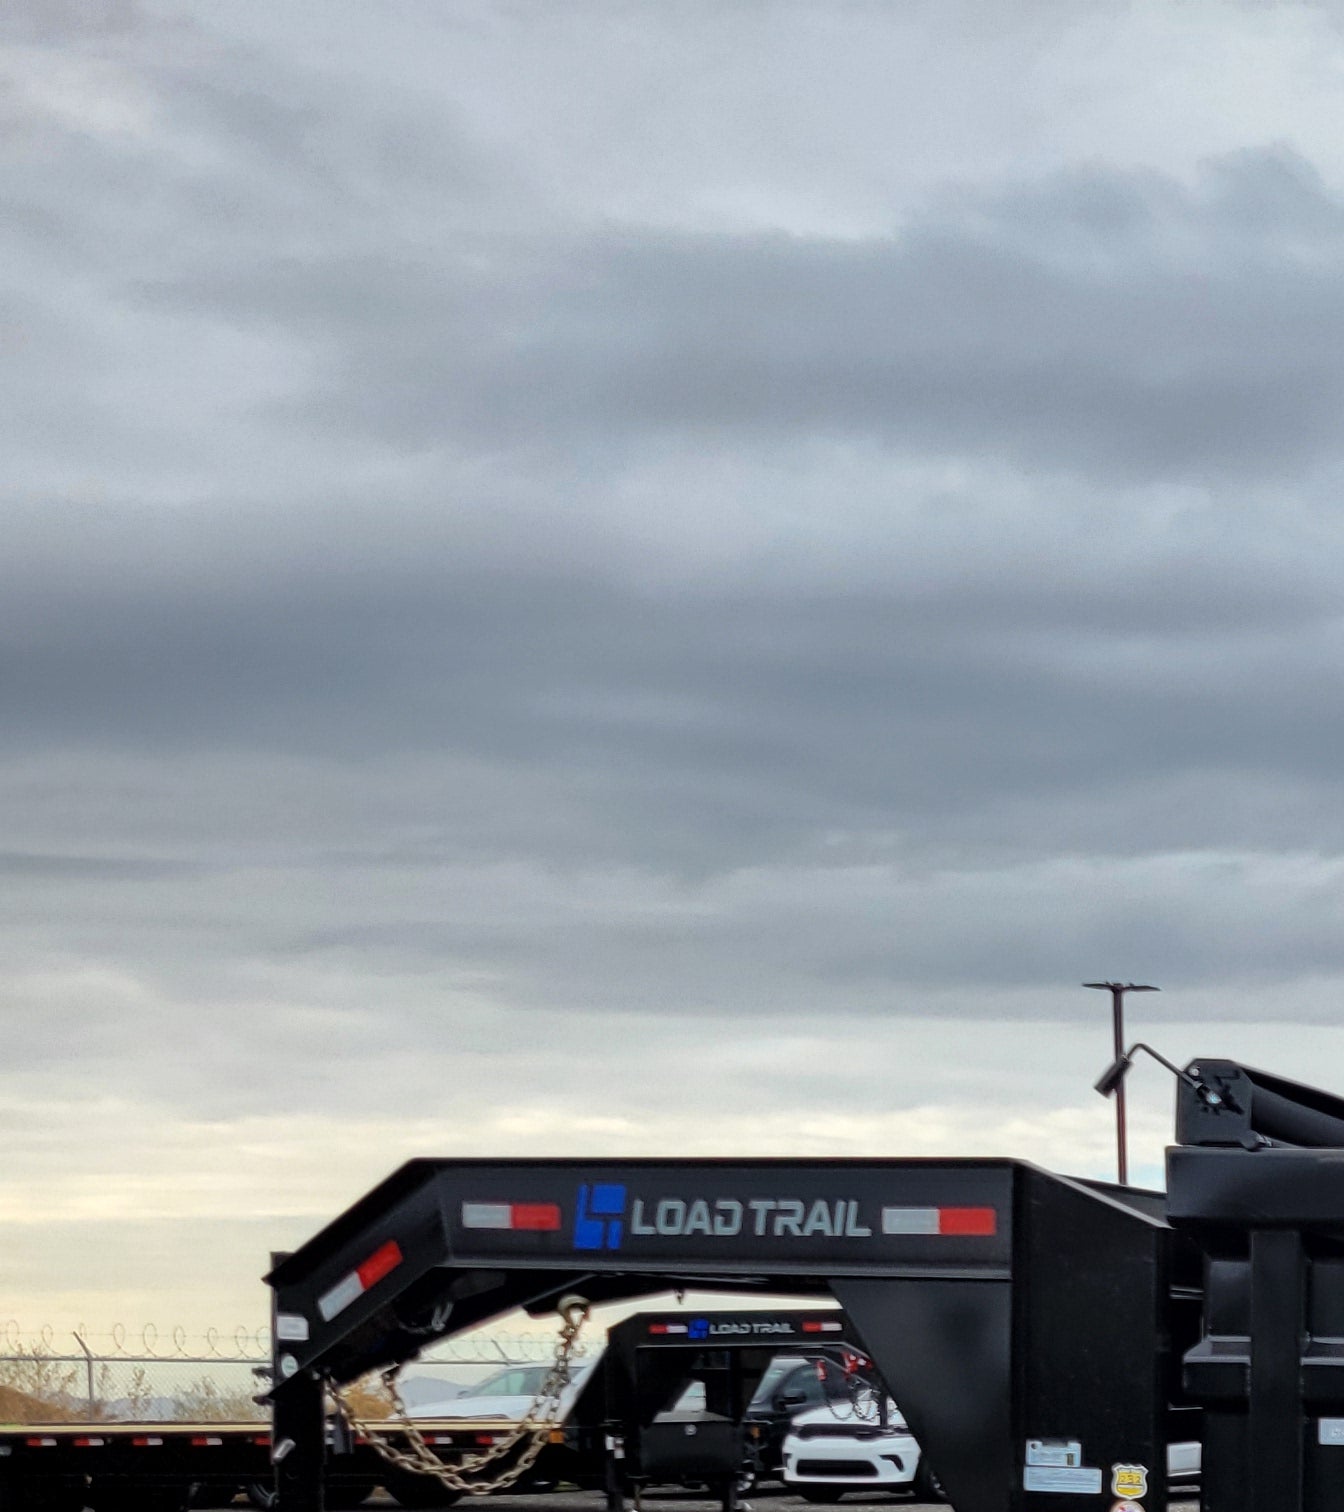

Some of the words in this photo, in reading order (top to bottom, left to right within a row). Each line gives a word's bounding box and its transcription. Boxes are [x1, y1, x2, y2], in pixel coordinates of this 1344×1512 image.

[630, 1200, 743, 1236] LOAD
[748, 1200, 872, 1237] TRAIL
[709, 1323, 751, 1334] LOAD
[752, 1323, 795, 1334] TRAIL
